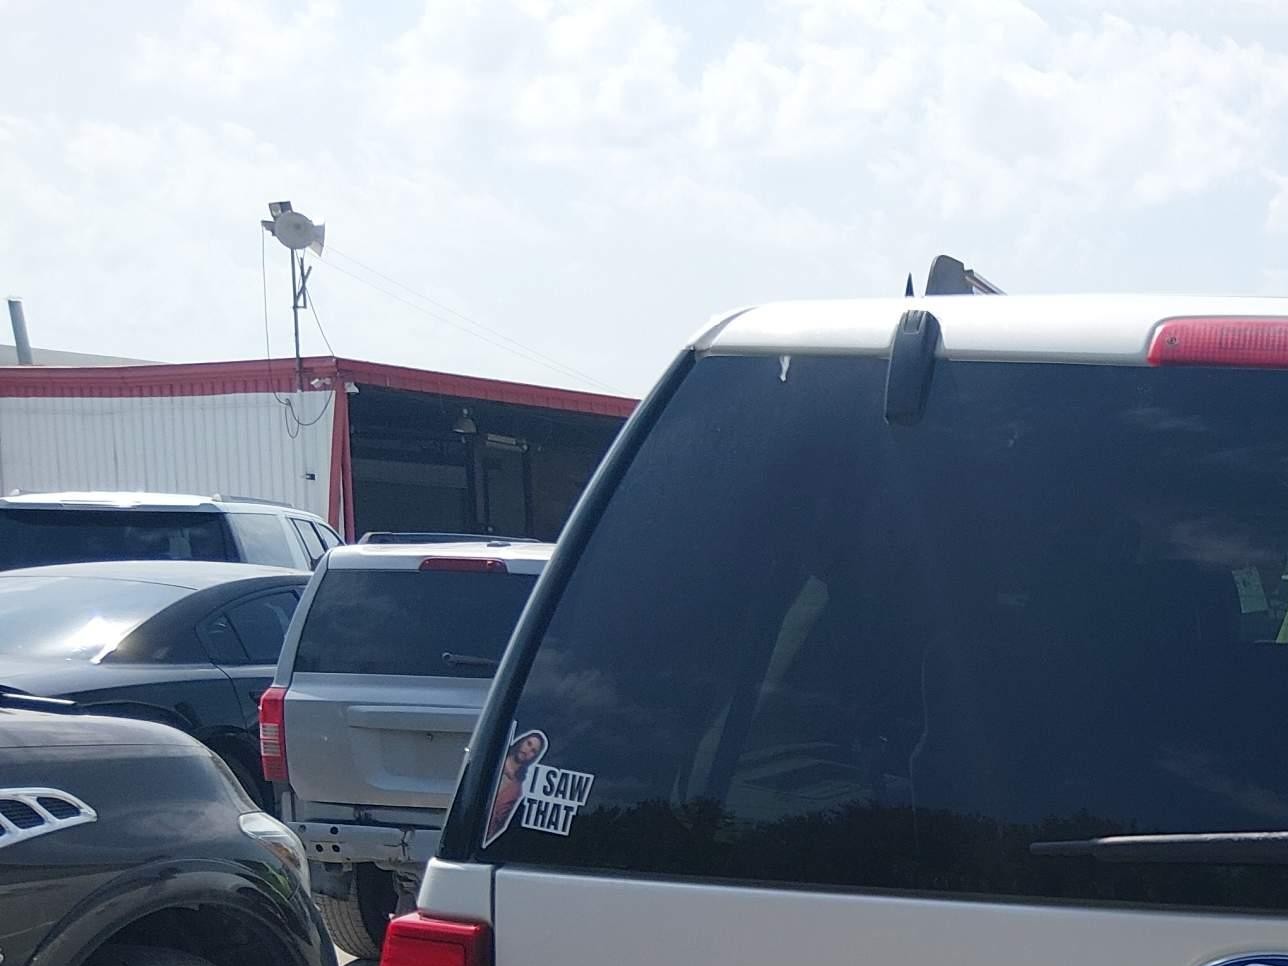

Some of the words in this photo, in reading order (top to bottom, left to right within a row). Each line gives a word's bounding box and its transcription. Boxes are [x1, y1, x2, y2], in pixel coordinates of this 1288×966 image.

[529, 767, 540, 793] I
[542, 770, 590, 803] SAW
[524, 798, 574, 833] THAT
